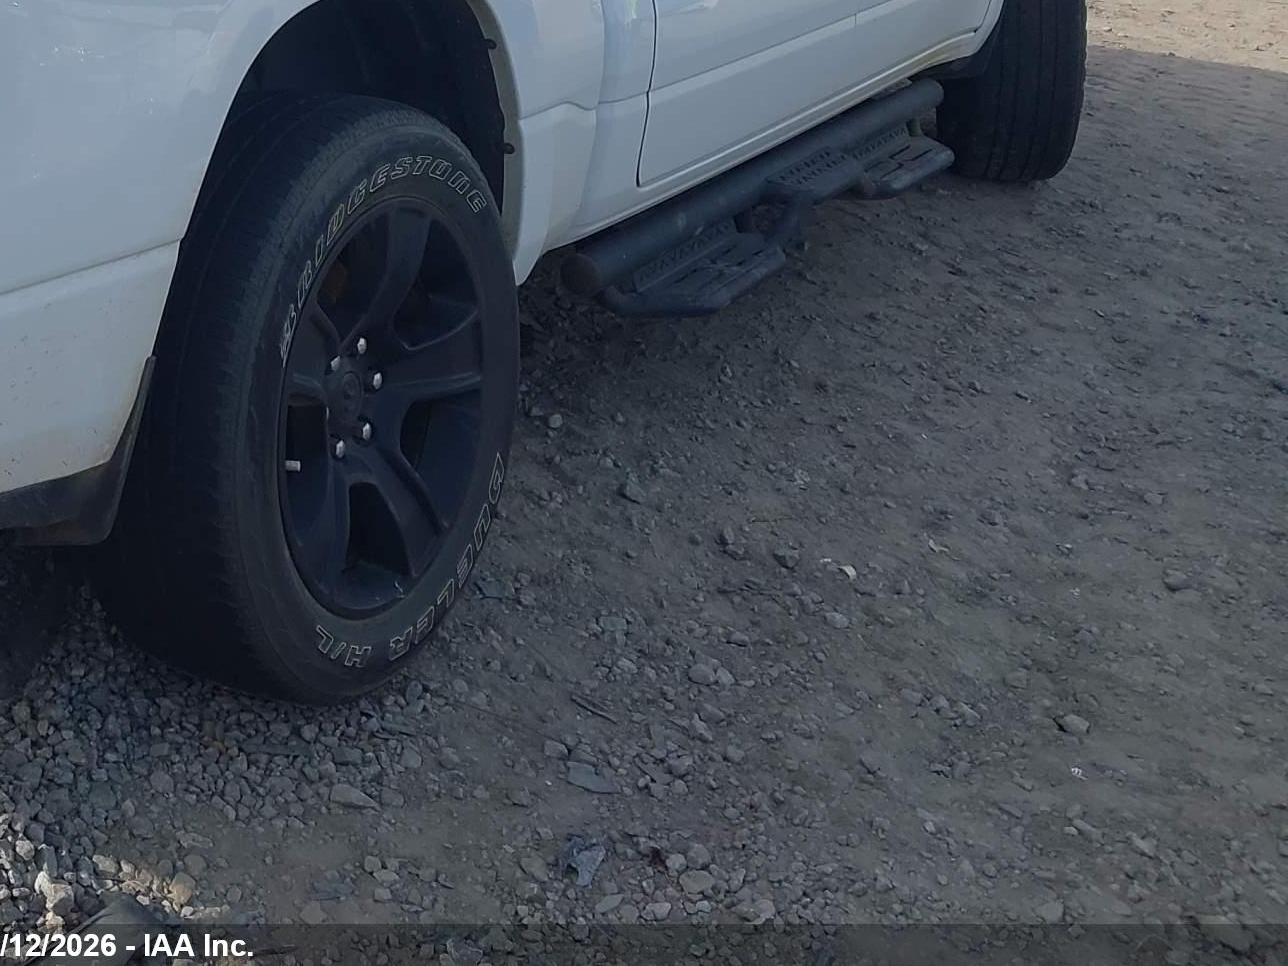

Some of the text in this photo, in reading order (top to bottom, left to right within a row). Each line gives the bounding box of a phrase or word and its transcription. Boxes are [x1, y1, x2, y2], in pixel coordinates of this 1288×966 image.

[279, 155, 487, 368] BRIDGESTONE
[316, 451, 505, 668] DUELER H/L
